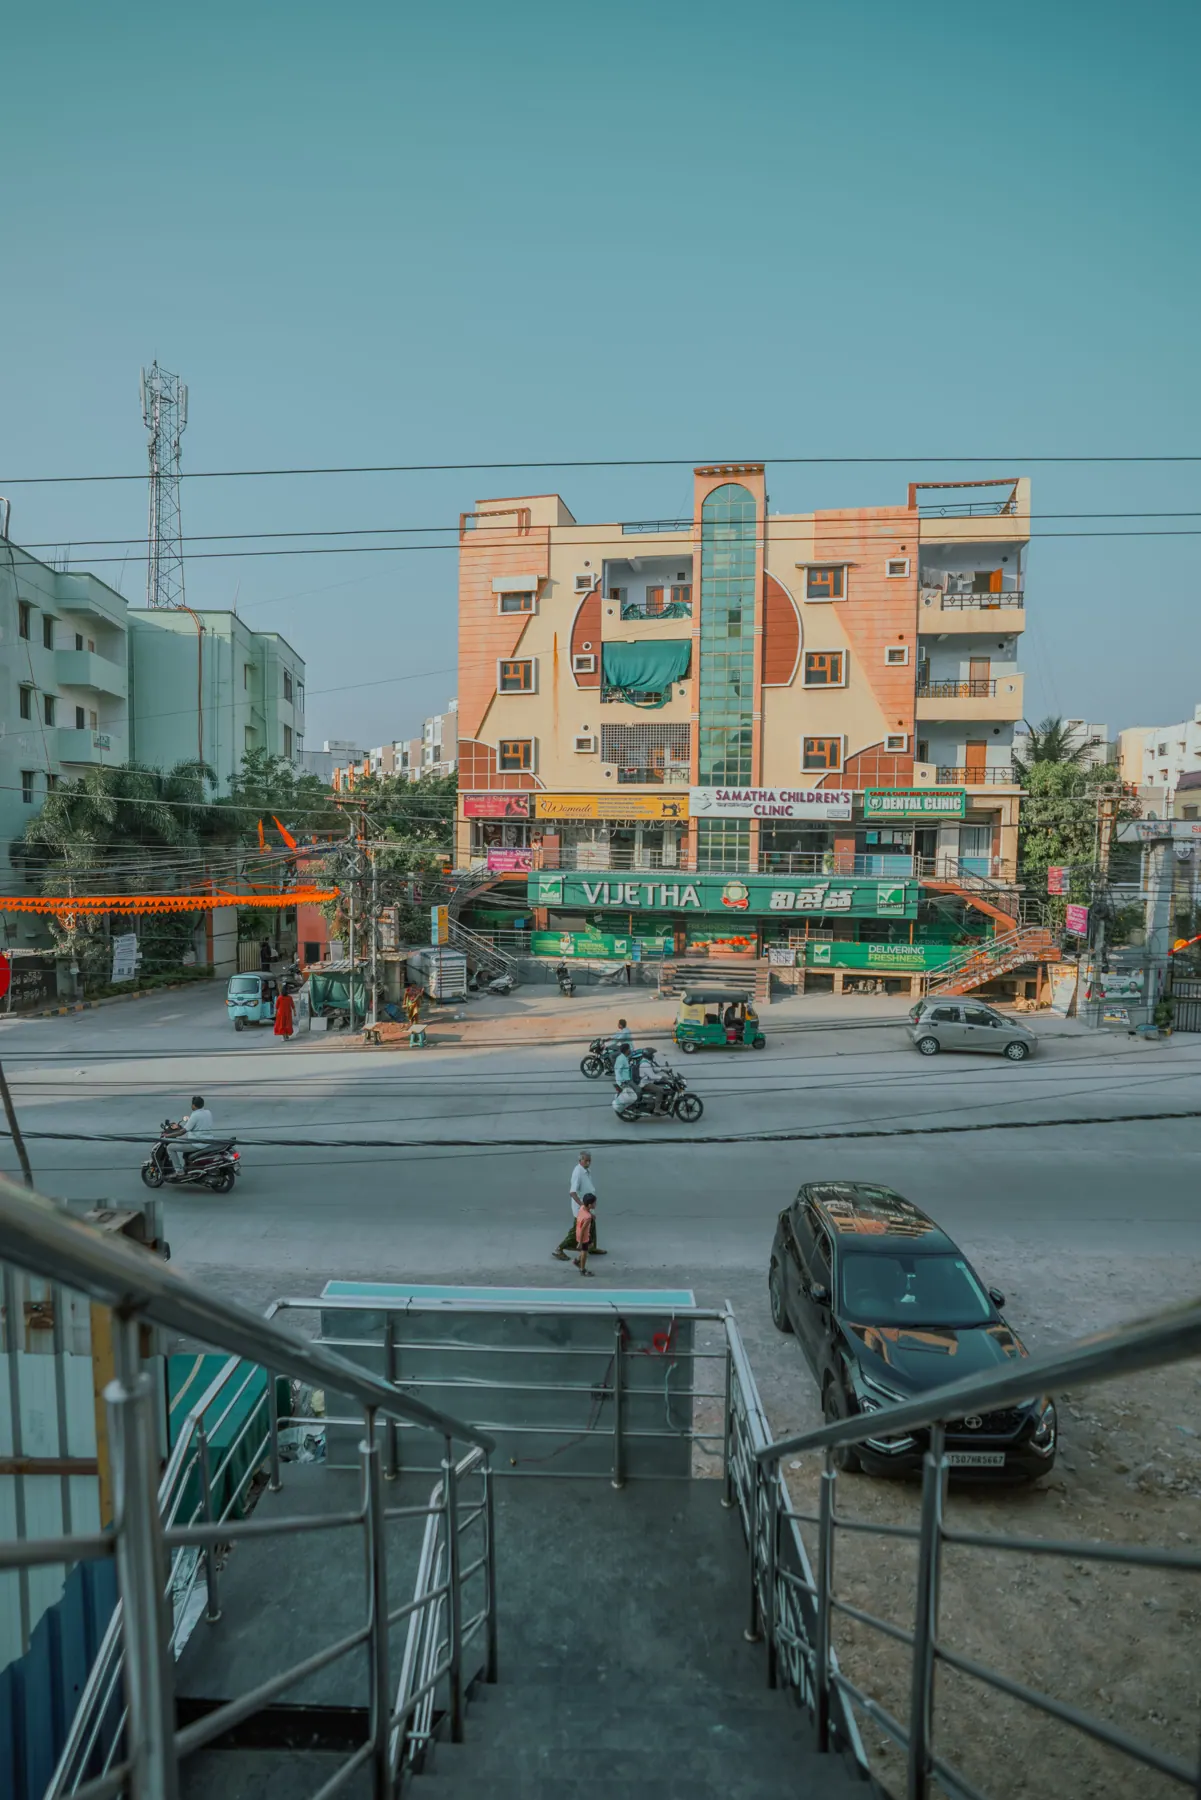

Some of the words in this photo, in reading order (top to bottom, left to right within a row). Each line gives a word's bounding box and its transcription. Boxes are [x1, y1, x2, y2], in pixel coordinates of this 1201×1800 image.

[716, 789, 776, 802] SAMATHA
[779, 790, 850, 804] CHILDREN'S
[882, 797, 922, 810] DENTAL
[924, 797, 961, 810] CLINIC
[753, 804, 794, 817] CLINIC
[581, 881, 702, 908] VIJETHA
[868, 945, 925, 954] DELIVERING
[868, 954, 926, 964] FRESHNESS,
